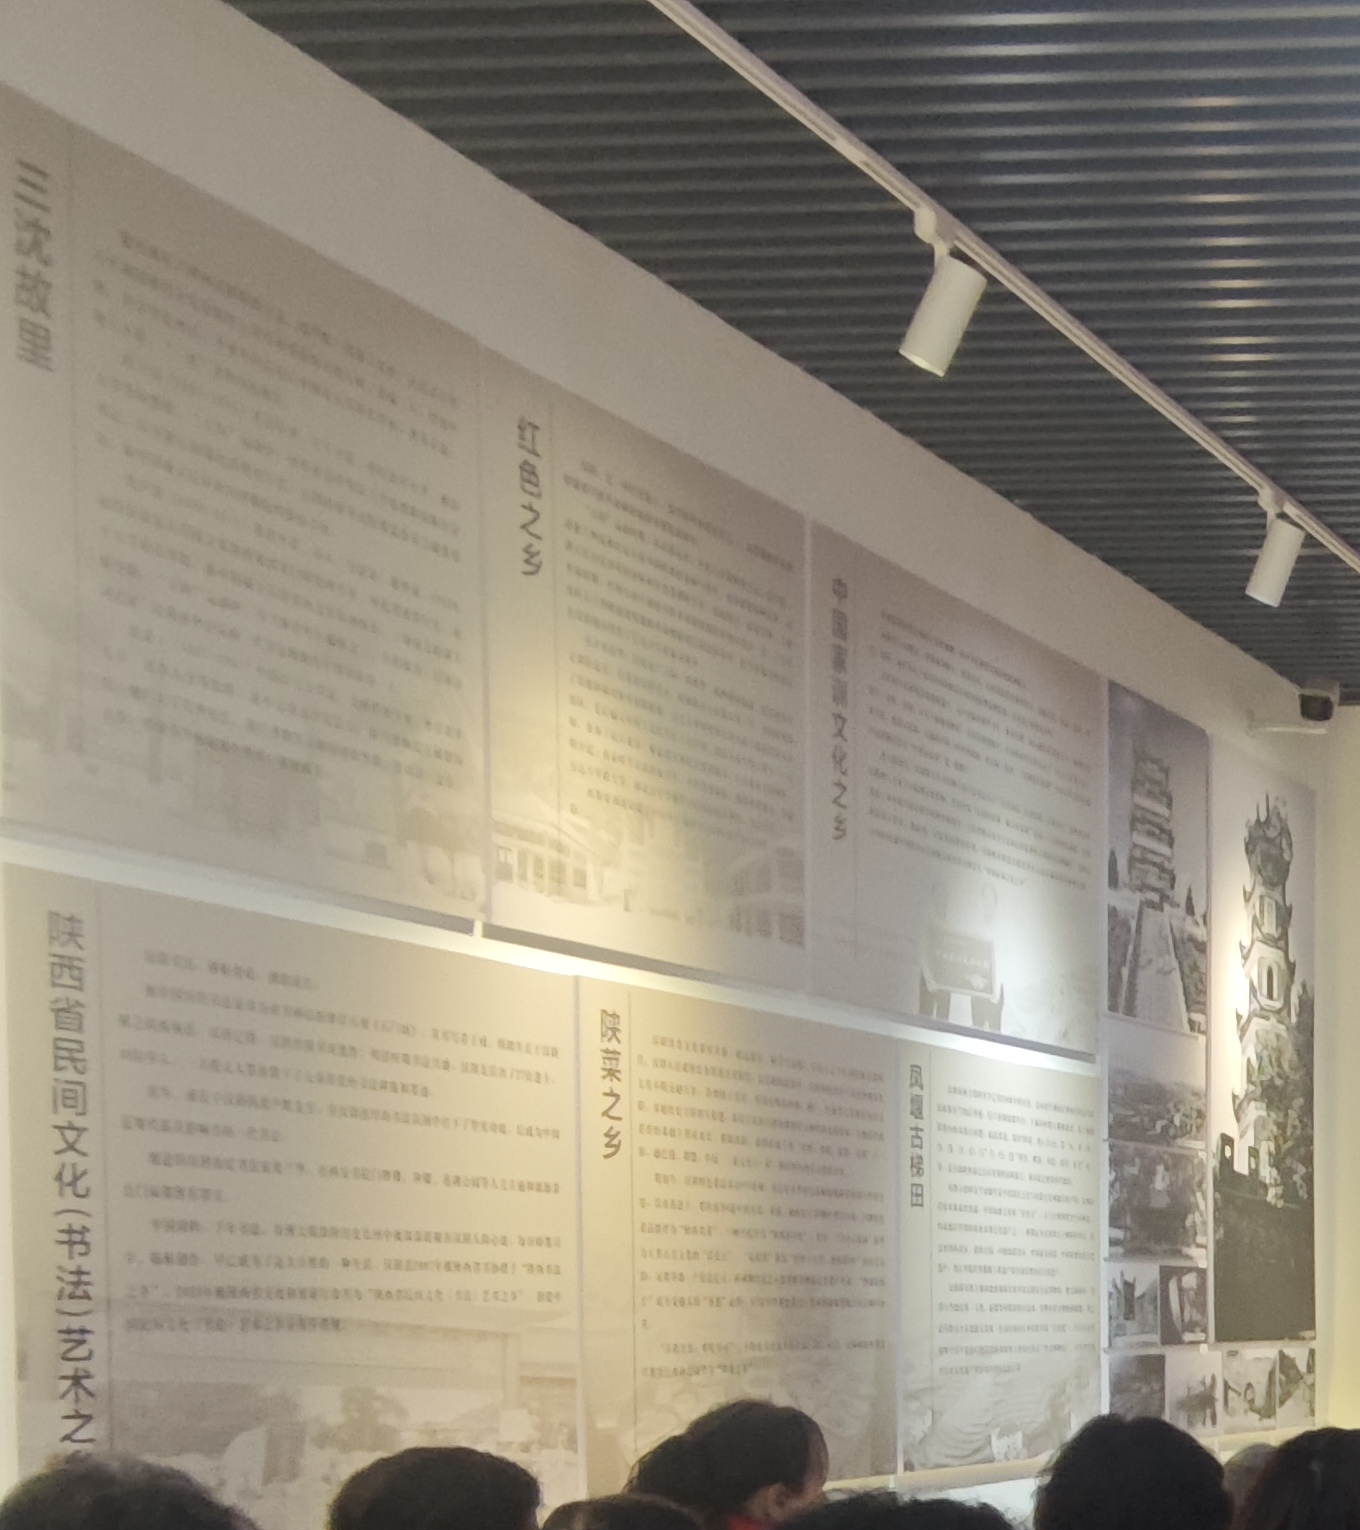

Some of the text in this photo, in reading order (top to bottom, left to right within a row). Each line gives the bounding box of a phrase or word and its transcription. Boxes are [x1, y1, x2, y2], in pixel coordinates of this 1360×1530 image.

[48, 909, 97, 1455] 陕西省民间文化（书法）艺术之
[599, 1008, 623, 1160] 陕菜之乡
